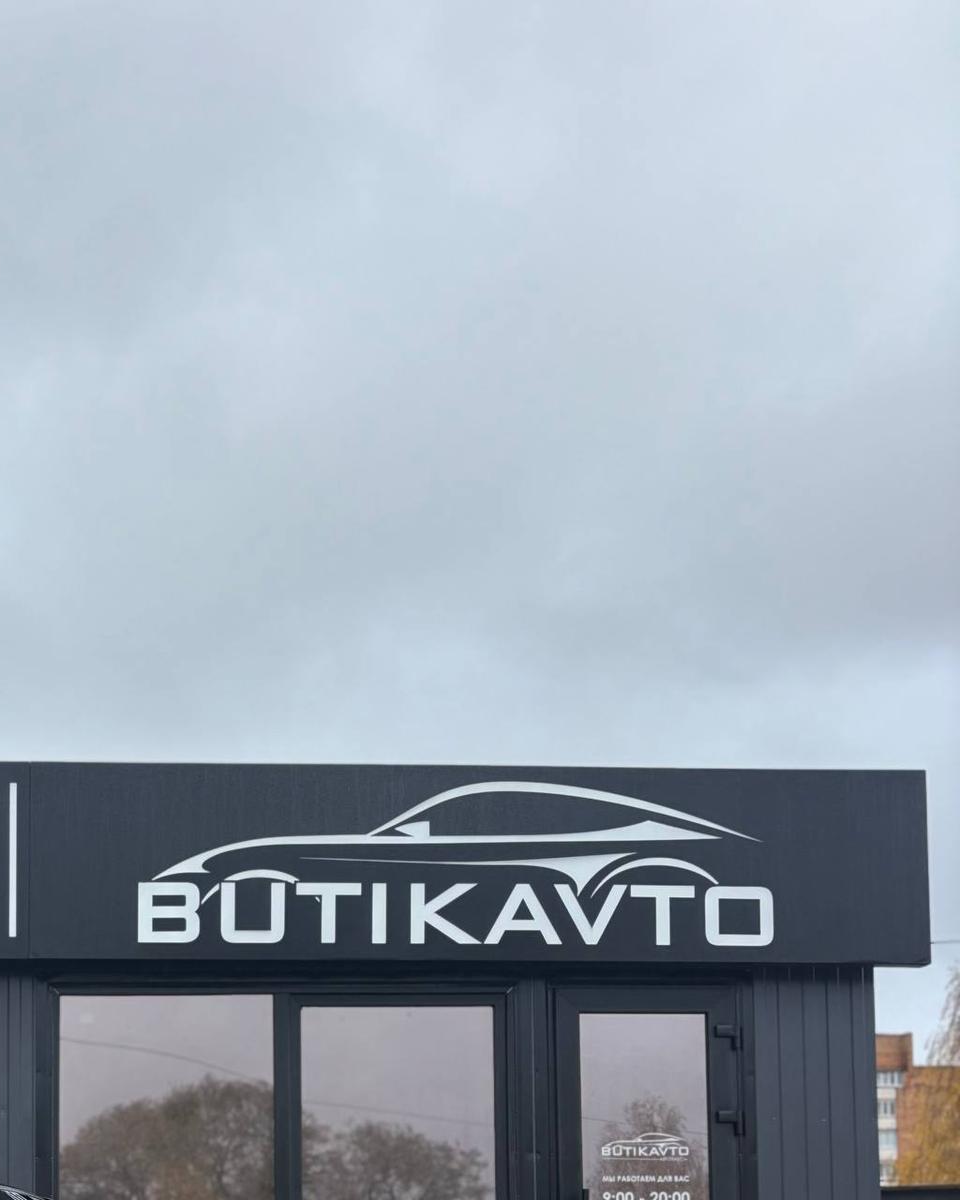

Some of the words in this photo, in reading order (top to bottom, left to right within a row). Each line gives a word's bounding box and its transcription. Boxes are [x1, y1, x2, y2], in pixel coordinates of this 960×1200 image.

[137, 881, 774, 946] BUTIKAVTO
[601, 1145, 690, 1156] BUTIKAVTO
[602, 1175, 615, 1183] МЫ
[617, 1175, 656, 1183] РАБОТАЕМ
[657, 1175, 673, 1183] ДЛЯ
[674, 1175, 690, 1183] ВАС
